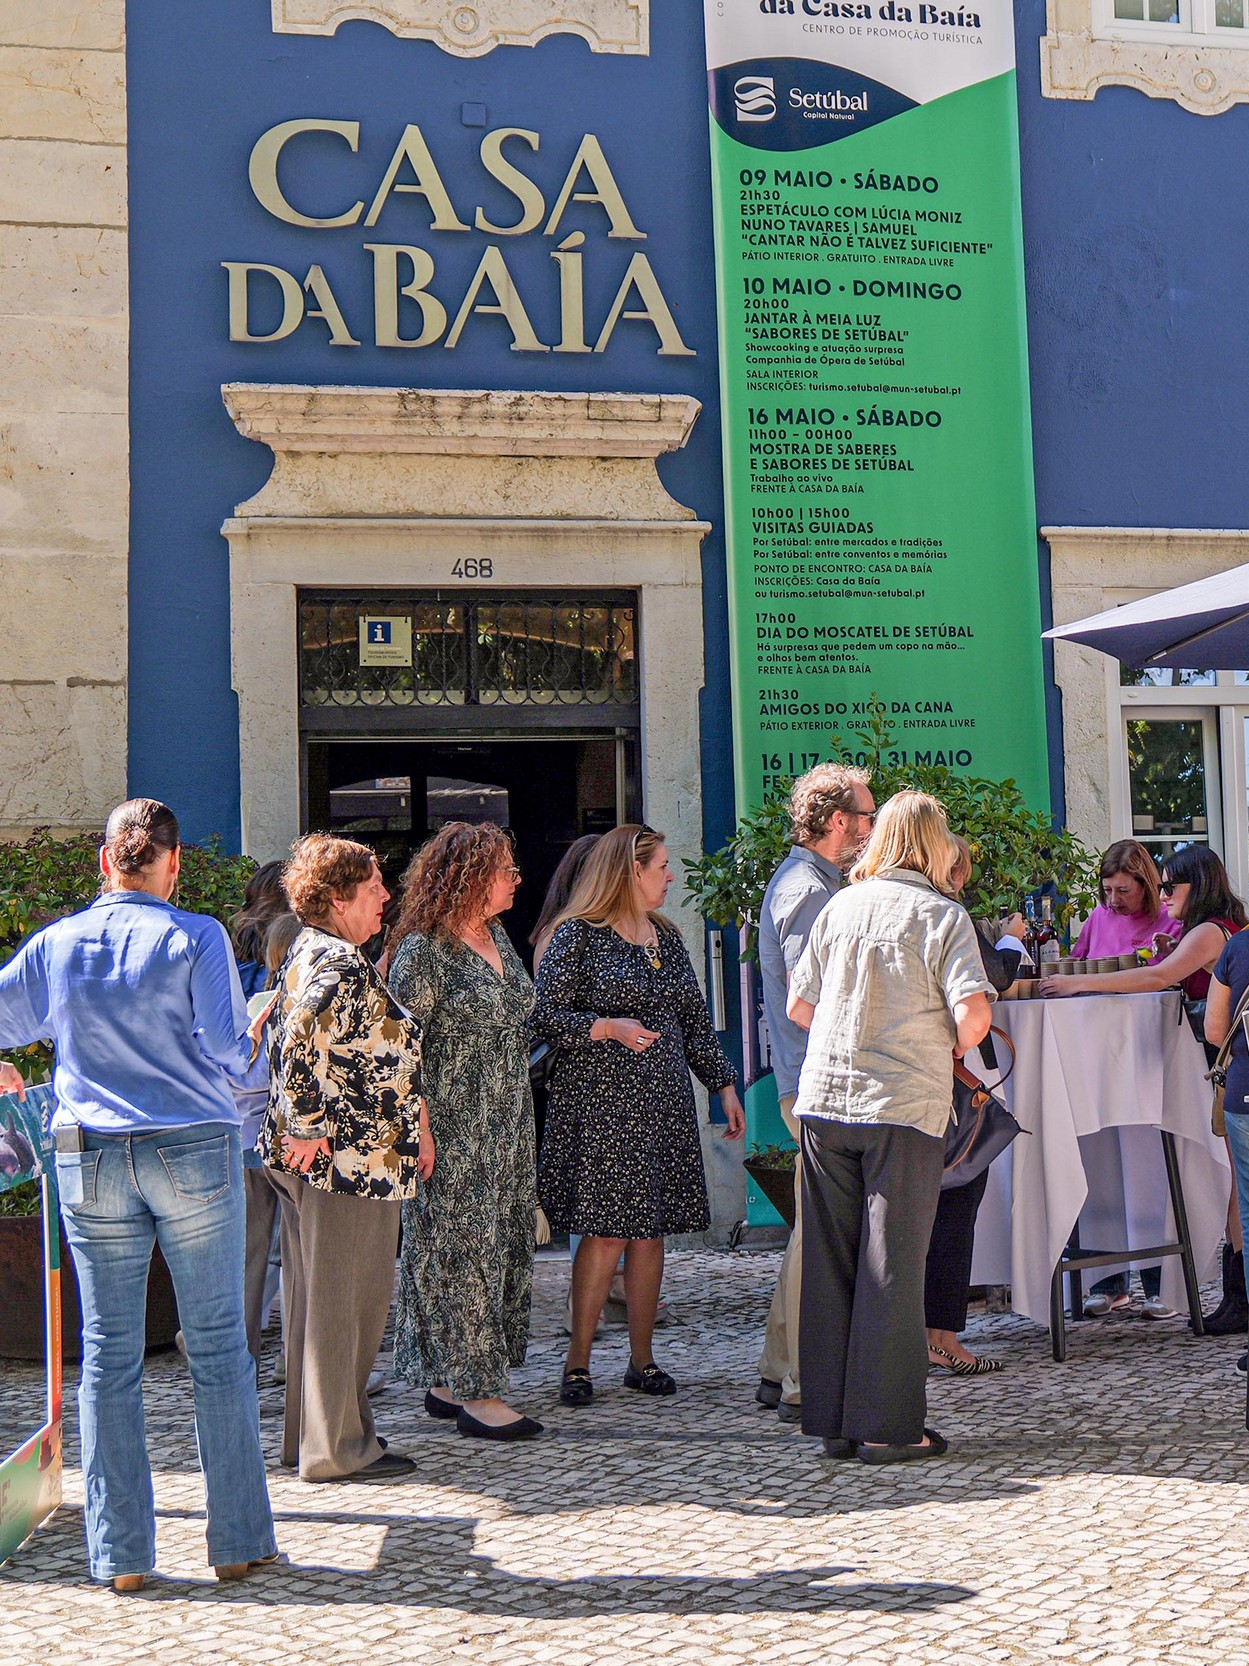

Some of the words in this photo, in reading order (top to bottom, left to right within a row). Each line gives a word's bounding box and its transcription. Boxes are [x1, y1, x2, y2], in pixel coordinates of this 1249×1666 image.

[759, 0, 794, 14] da
[802, 0, 871, 19] Casa
[879, 1, 912, 22] da
[919, 4, 981, 28] Baía
[802, 24, 844, 34] CENTRO
[848, 25, 862, 36] DE
[866, 28, 928, 40] PROMOÇÃO
[932, 32, 982, 44] TURÍSTICA
[789, 88, 867, 111] Setúbal
[802, 111, 828, 120] Capital
[829, 112, 855, 120] Natural
[248, 118, 647, 239] CASA
[740, 169, 766, 185] 09
[774, 170, 832, 187] MAIO
[854, 169, 938, 193] SÁBADO
[739, 190, 780, 200] 21h30
[741, 202, 829, 217] ESPETÁCULO
[833, 206, 866, 218] COM
[872, 205, 911, 220] LÚCIA
[915, 210, 962, 223] MONIZ
[741, 219, 785, 230] NUNO
[788, 220, 849, 234] TAVARES
[862, 222, 917, 235] SAMUEL
[810, 232, 841, 247] NÃO
[846, 233, 853, 247] É
[857, 237, 906, 250] TALVEZ
[741, 250, 770, 260] PÁTIO
[773, 251, 820, 262] INTERIOR
[826, 253, 876, 264] GRATUITO
[883, 255, 927, 266] ENTRADA
[928, 257, 954, 268] LIVRE
[220, 261, 361, 346] DA
[363, 231, 697, 355] BAÍA
[744, 278, 764, 294] 10
[773, 278, 831, 295] MAIO
[853, 280, 961, 300] DOMINGO
[743, 299, 788, 309] 20h00
[744, 313, 797, 324] JANTAR
[802, 310, 812, 324] À
[815, 314, 851, 325] MEIA
[855, 315, 881, 326] LUZ
[744, 328, 817, 339] “SABORES
[821, 329, 839, 340] DE
[745, 343, 809, 353] Showcooking
[812, 345, 819, 353] e
[821, 345, 861, 355] atuação
[863, 346, 904, 356] surpresa
[745, 355, 801, 365] Companhia
[804, 355, 818, 365] de
[819, 354, 850, 366] Ópera
[853, 356, 867, 365] de
[868, 356, 905, 367] Setúbal
[746, 369, 771, 379] SALA
[772, 370, 818, 381] INTERIOR
[746, 380, 805, 392] INSCRIÇÕES:
[808, 383, 960, 396] turismo.setubal@mun-setubal.pt
[749, 408, 768, 425] 16
[776, 408, 834, 425] MAIO
[857, 405, 941, 427] SÁBADO
[748, 429, 786, 439] 11h00
[805, 429, 852, 440] 00H00
[749, 443, 810, 455] MOSTRA
[814, 444, 832, 454] DE
[837, 444, 896, 456] SABERES
[750, 458, 757, 469] E
[761, 459, 827, 470] SABORES
[831, 459, 849, 470] DE
[855, 456, 914, 471] SETÚBAL
[749, 474, 794, 484] Trabalho
[796, 475, 810, 483] ao
[812, 473, 834, 483] vivo
[750, 484, 787, 494] FRENTE
[788, 481, 796, 492] À
[798, 484, 823, 494] CASA
[825, 484, 840, 493] DA
[841, 482, 864, 493] BAÍA
[751, 508, 793, 518] 10h00
[808, 508, 849, 518] 15h00
[751, 522, 804, 533] VISITAS
[808, 522, 873, 533] GUIADAS
[752, 537, 769, 546] Por
[771, 536, 812, 547] Setúbal:
[814, 537, 840, 546] entre
[842, 537, 889, 546] mercados
[890, 539, 897, 547] e
[899, 538, 942, 548] tradições
[753, 549, 770, 559] Por
[771, 549, 813, 559] Setúbal:
[814, 550, 841, 559] entre
[842, 550, 891, 559] conventos
[892, 551, 900, 559] e
[901, 549, 948, 559] memórias
[450, 557, 493, 578] 468
[753, 564, 790, 574] PONTO
[792, 564, 806, 574] DE
[808, 564, 866, 574] ENCONTRO:
[868, 564, 893, 573] CASA
[894, 564, 909, 573] DA
[910, 563, 932, 573] BAÍA
[754, 575, 813, 587] INSCRIÇÕES:
[815, 576, 840, 586] Casa
[842, 576, 856, 586] da
[858, 576, 881, 586] Baía
[769, 589, 924, 599] turismo.setubal@mun-setubal.pt
[755, 613, 795, 623] 17h00
[756, 627, 781, 638] DIA
[786, 627, 809, 638] DO
[813, 627, 888, 638] MOSCATEL
[892, 626, 910, 637] DE
[914, 623, 973, 637] SETÚBAL
[756, 642, 771, 652] Há
[773, 644, 819, 655] surpresas
[820, 643, 840, 653] que
[842, 642, 876, 652] pedem
[878, 643, 894, 651] um
[895, 643, 920, 652] copo
[936, 641, 965, 650] mão...
[765, 653, 792, 663] olhos
[794, 652, 817, 662] bem
[818, 653, 859, 662] atentos.
[757, 665, 794, 675] FRENTE
[795, 664, 802, 674] À
[804, 665, 830, 675] CASA
[832, 664, 847, 674] DA
[848, 663, 871, 673] BAÍA
[758, 689, 798, 700] 21h30
[759, 704, 819, 715] AMIGOS
[824, 703, 847, 714] DO
[891, 702, 910, 713] DA
[914, 702, 953, 713] CANA
[759, 720, 788, 730] PÁTIO
[791, 720, 839, 731] EXTERIOR
[903, 719, 948, 729] ENTRADA
[949, 718, 976, 728] LIVRE
[762, 754, 781, 770] 16
[801, 753, 819, 770] 17
[888, 751, 908, 770] 31
[915, 750, 972, 767] MAIO
